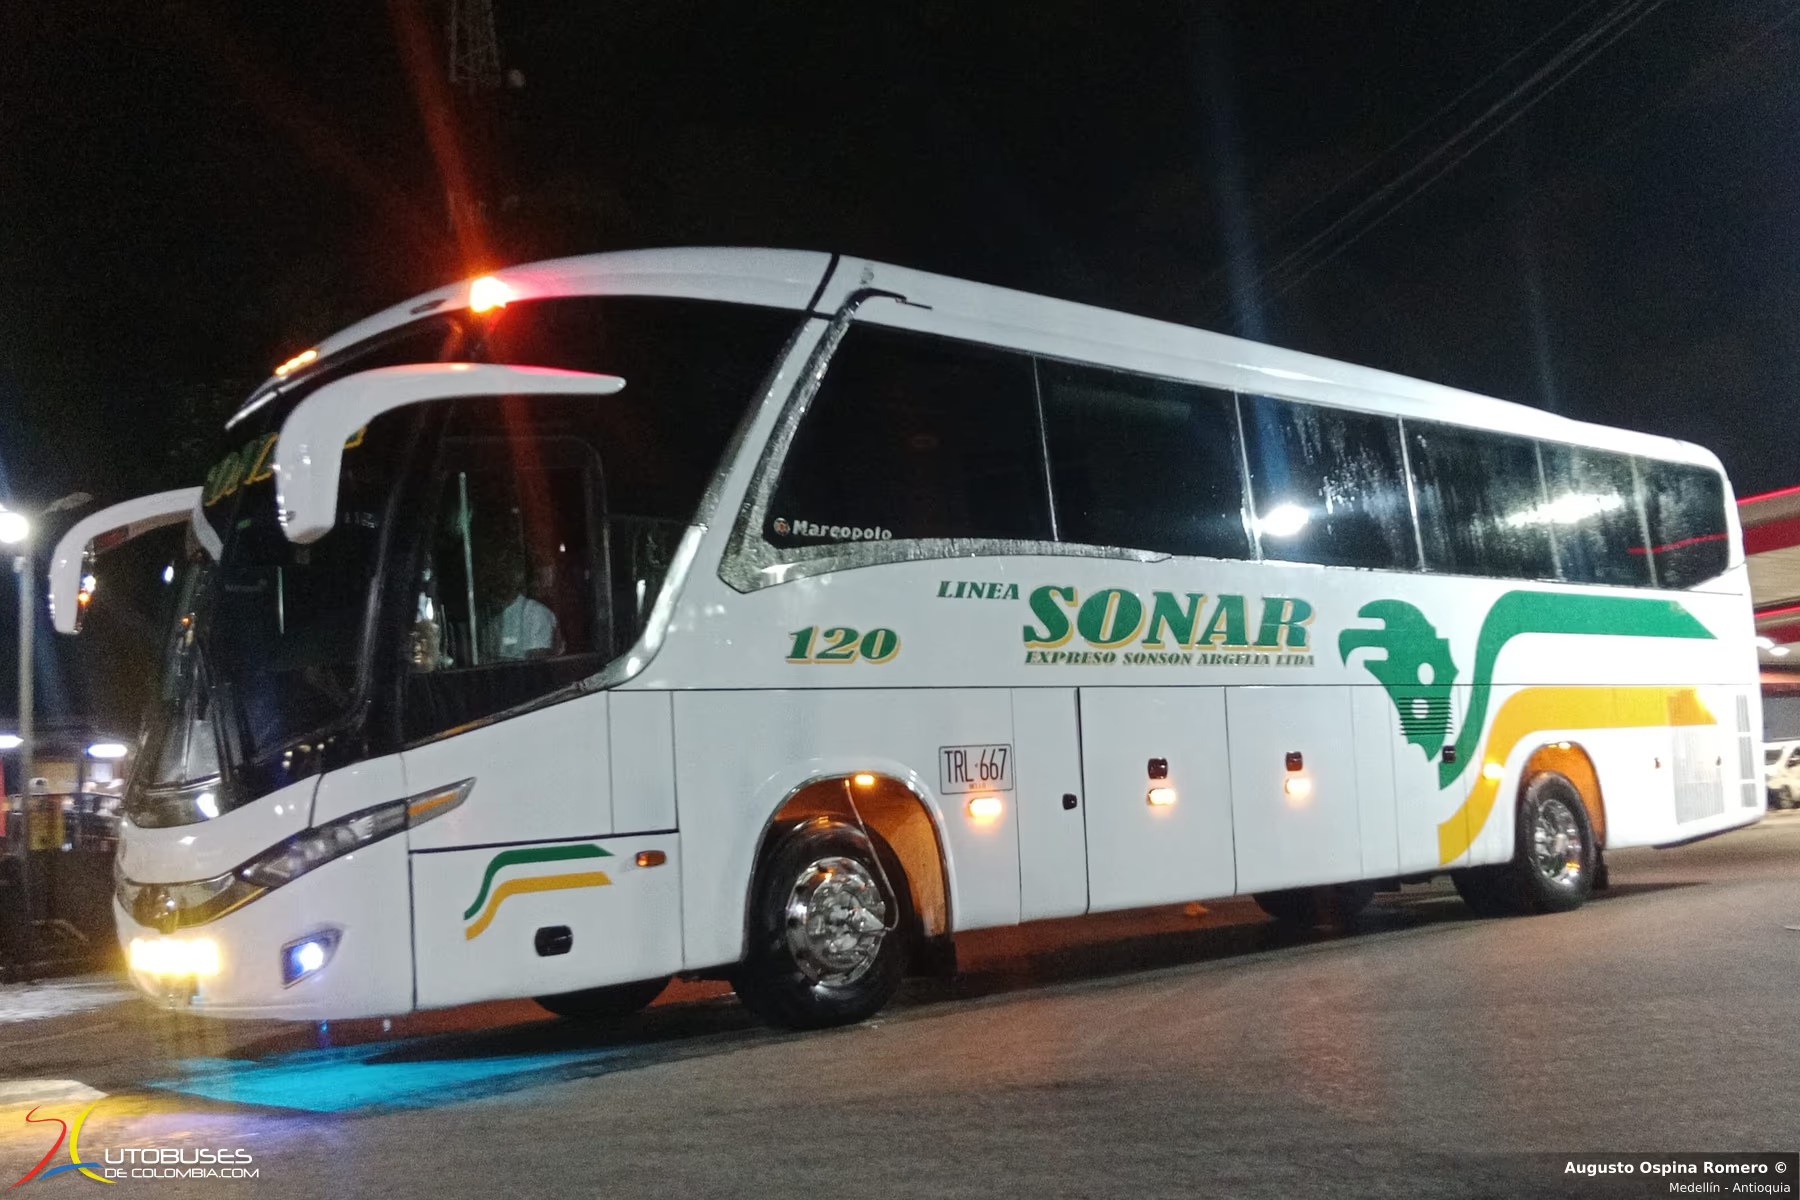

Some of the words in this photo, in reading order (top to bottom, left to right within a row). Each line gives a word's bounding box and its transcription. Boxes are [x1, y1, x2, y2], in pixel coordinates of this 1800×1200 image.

[792, 520, 893, 540] Marcopolo
[936, 580, 1020, 600] LINEA
[1023, 584, 1317, 653] SONAR
[784, 625, 901, 665] 120
[1024, 650, 1117, 666] EXPRESO
[1121, 651, 1193, 667] SONSON
[1275, 654, 1316, 668] LTDA
